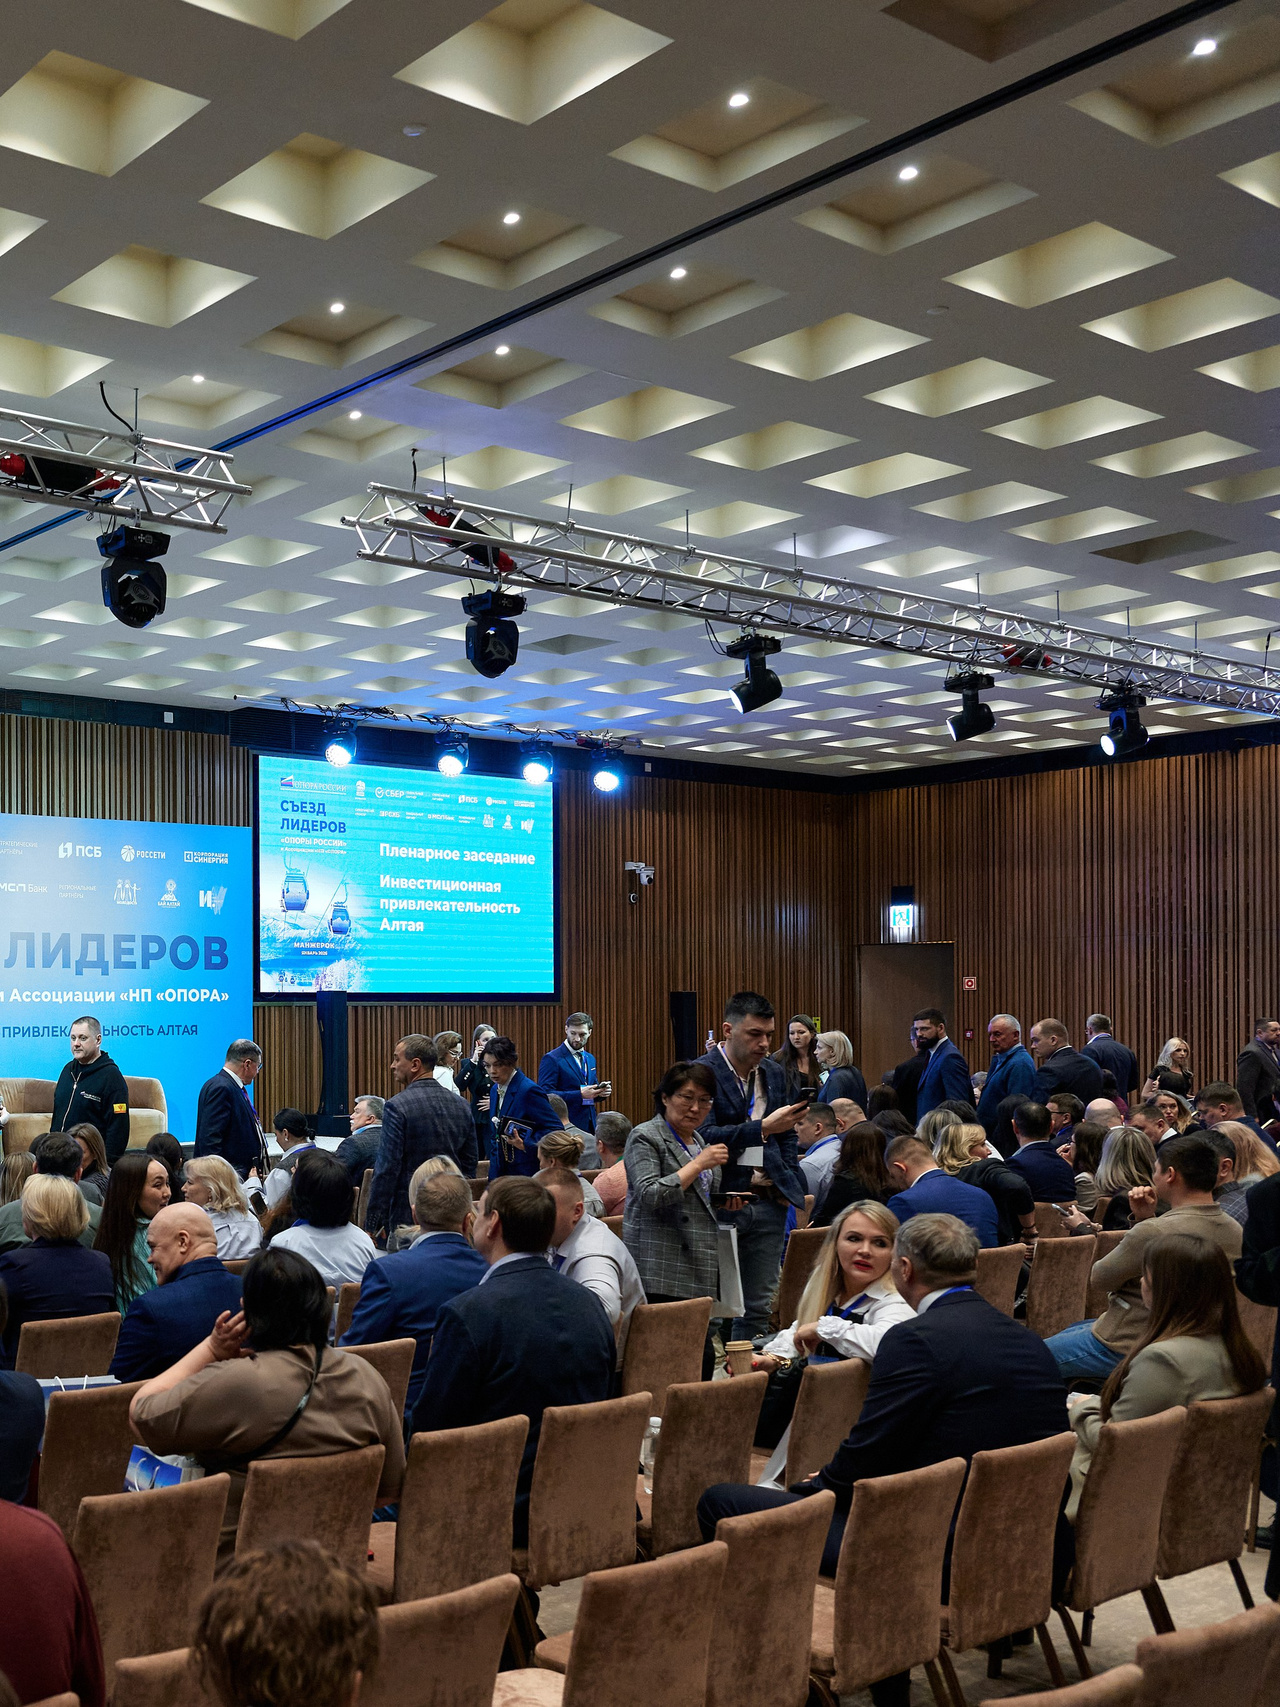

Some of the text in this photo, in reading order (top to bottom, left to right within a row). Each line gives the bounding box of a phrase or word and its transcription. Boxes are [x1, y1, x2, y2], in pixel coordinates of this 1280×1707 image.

[385, 790, 404, 798] СБЕР
[280, 800, 326, 816] СЪЕЗД
[280, 818, 346, 833] ЛИДЕРОВ
[75, 845, 102, 858] ПСБ
[136, 850, 166, 859] РОССЕТИ
[379, 843, 536, 865] Пленарное заседание
[28, 883, 48, 893] Банк
[379, 875, 502, 893] Инвестиционная
[380, 899, 521, 914] привлекательность
[380, 918, 424, 932] Алтая
[4, 932, 229, 976] ЛИДЕРОВ
[9, 988, 115, 1004] Ассоциации
[120, 989, 152, 1002] «НП
[156, 988, 229, 1002] «ОПОРА»
[2, 1025, 154, 1038] ПРИВЛЕКЬНОСТЬ
[157, 1025, 198, 1036] АЛТАЯ
